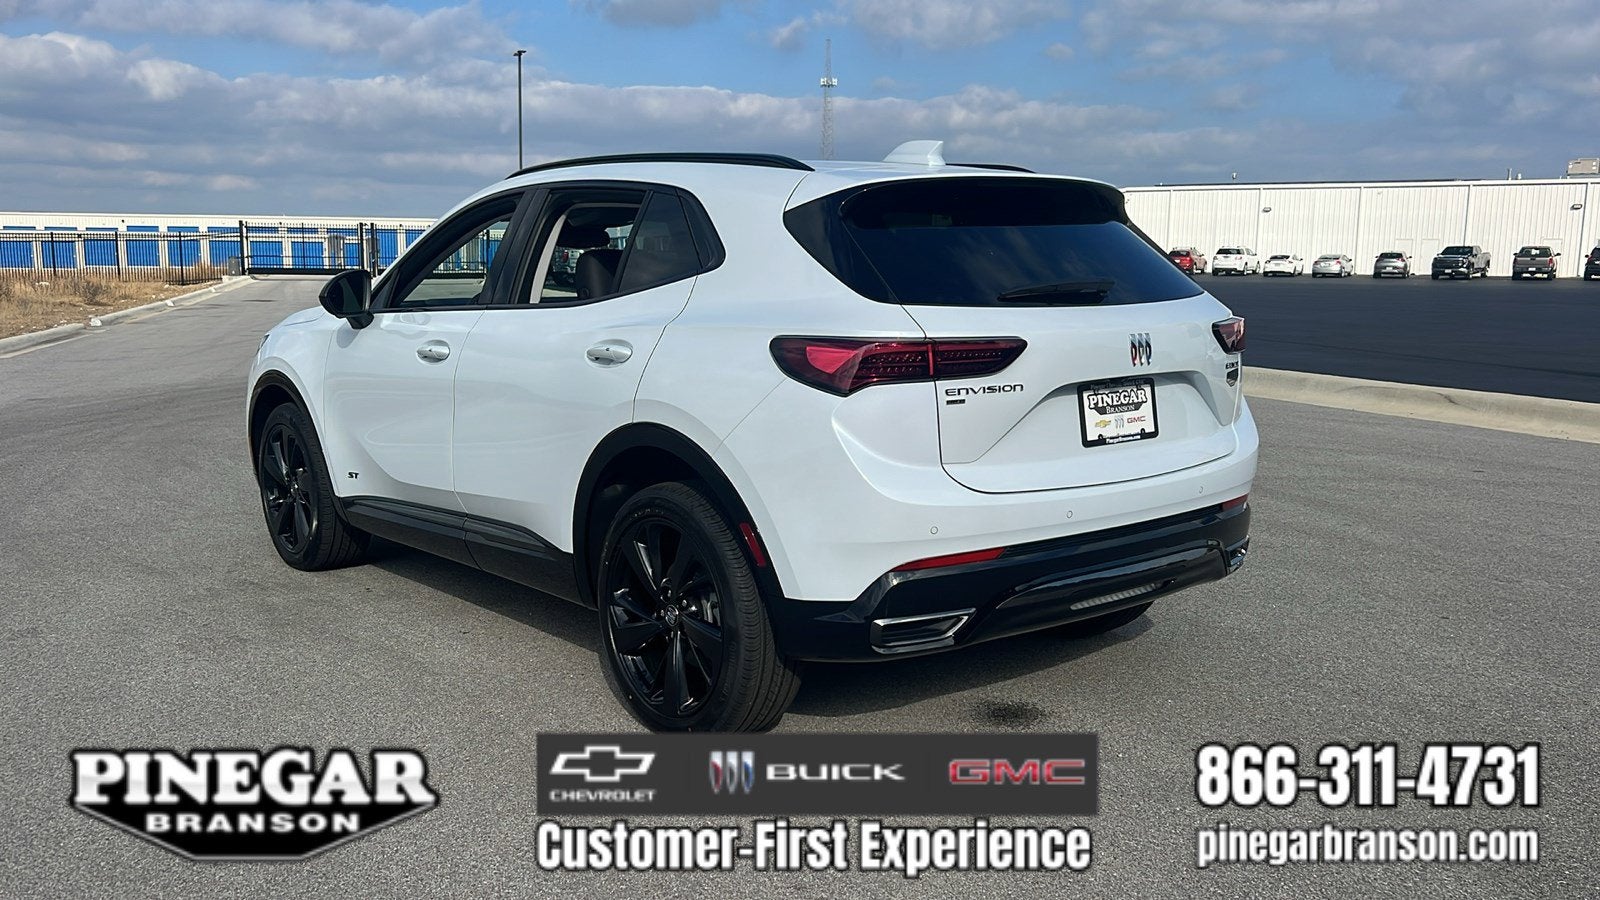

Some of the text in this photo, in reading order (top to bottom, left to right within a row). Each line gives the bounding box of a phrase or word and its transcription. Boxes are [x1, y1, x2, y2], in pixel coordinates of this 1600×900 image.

[945, 384, 1024, 396] ENVISION
[1088, 389, 1148, 409] PINEGAR
[1106, 405, 1135, 413] BRANSON
[1127, 416, 1146, 424] GMC
[347, 471, 359, 479] ST
